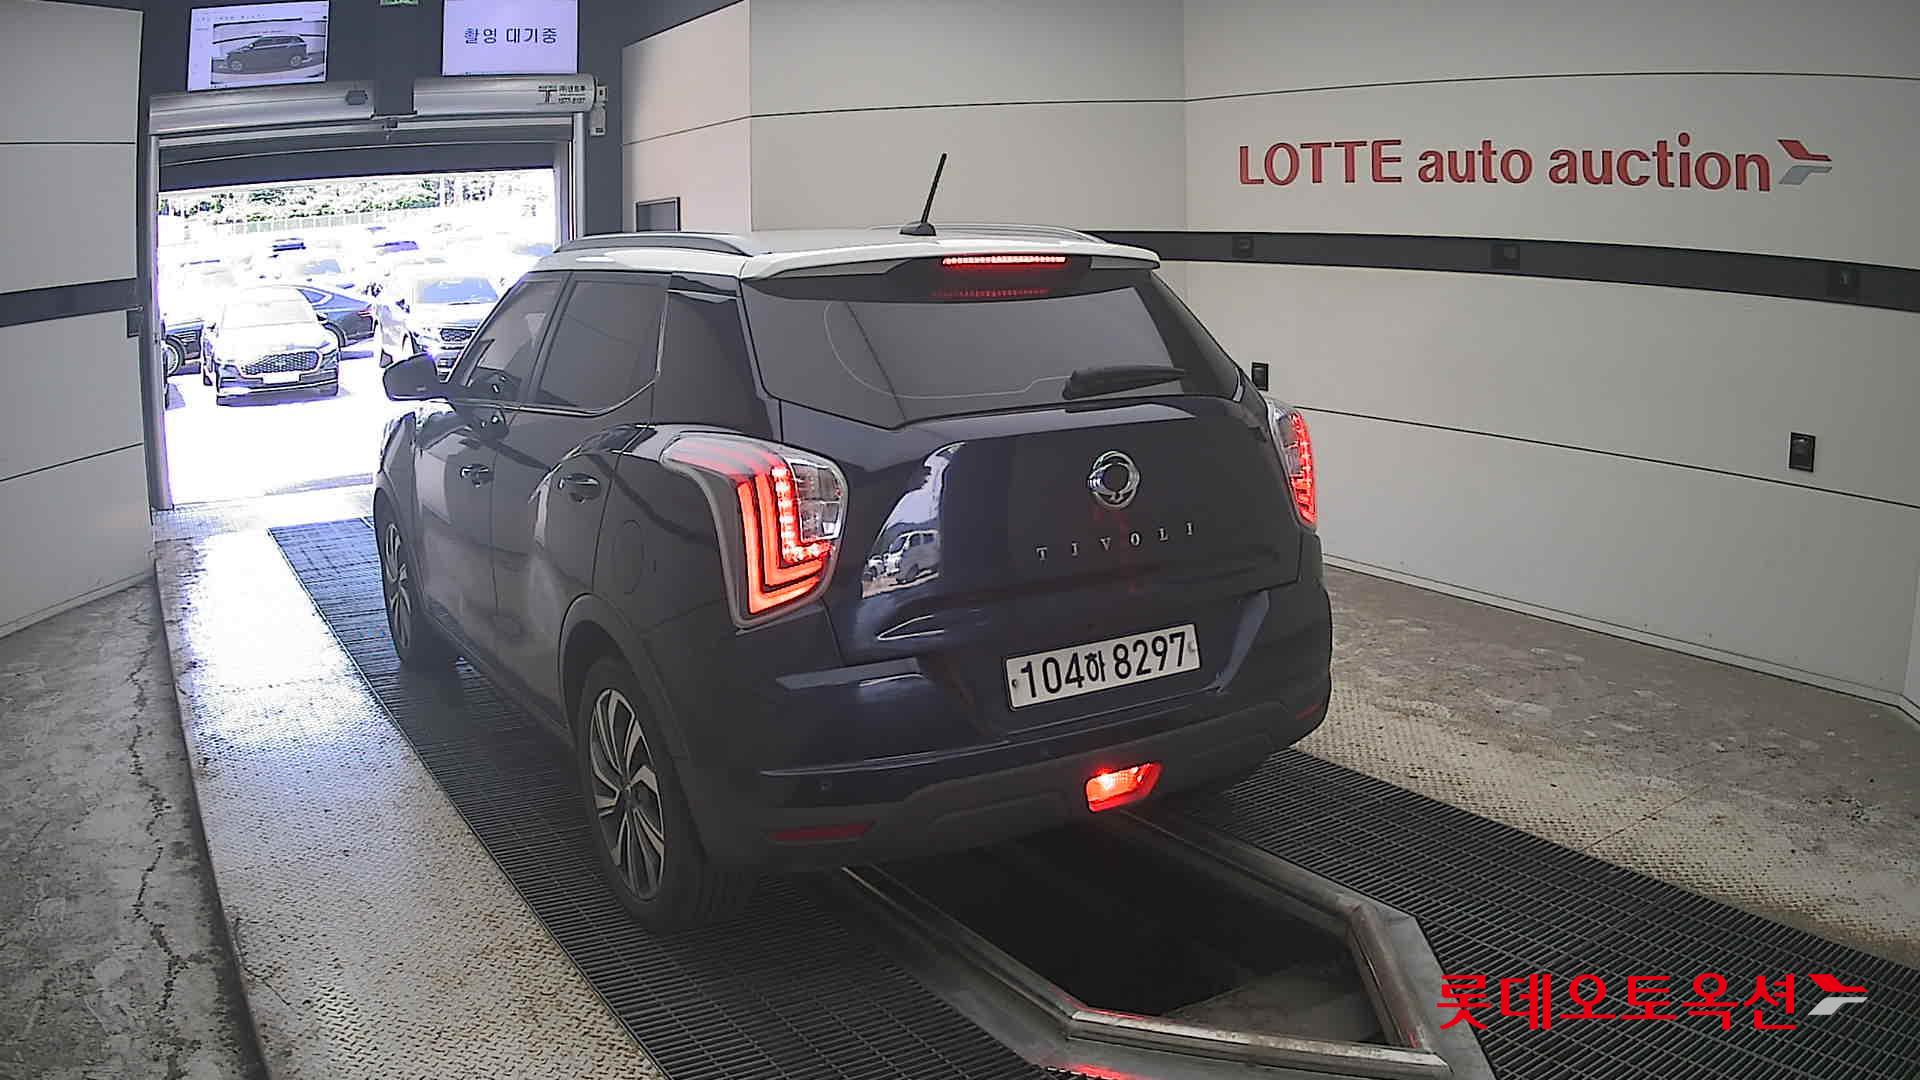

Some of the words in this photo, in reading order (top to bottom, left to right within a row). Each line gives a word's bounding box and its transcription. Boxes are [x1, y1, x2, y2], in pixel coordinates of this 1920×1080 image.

[505, 27, 558, 44] 대기중
[1240, 139, 1402, 185] LOTTE
[1418, 139, 1533, 184] auto
[1547, 132, 1771, 192] auction
[1036, 522, 1194, 560] TIVOLI
